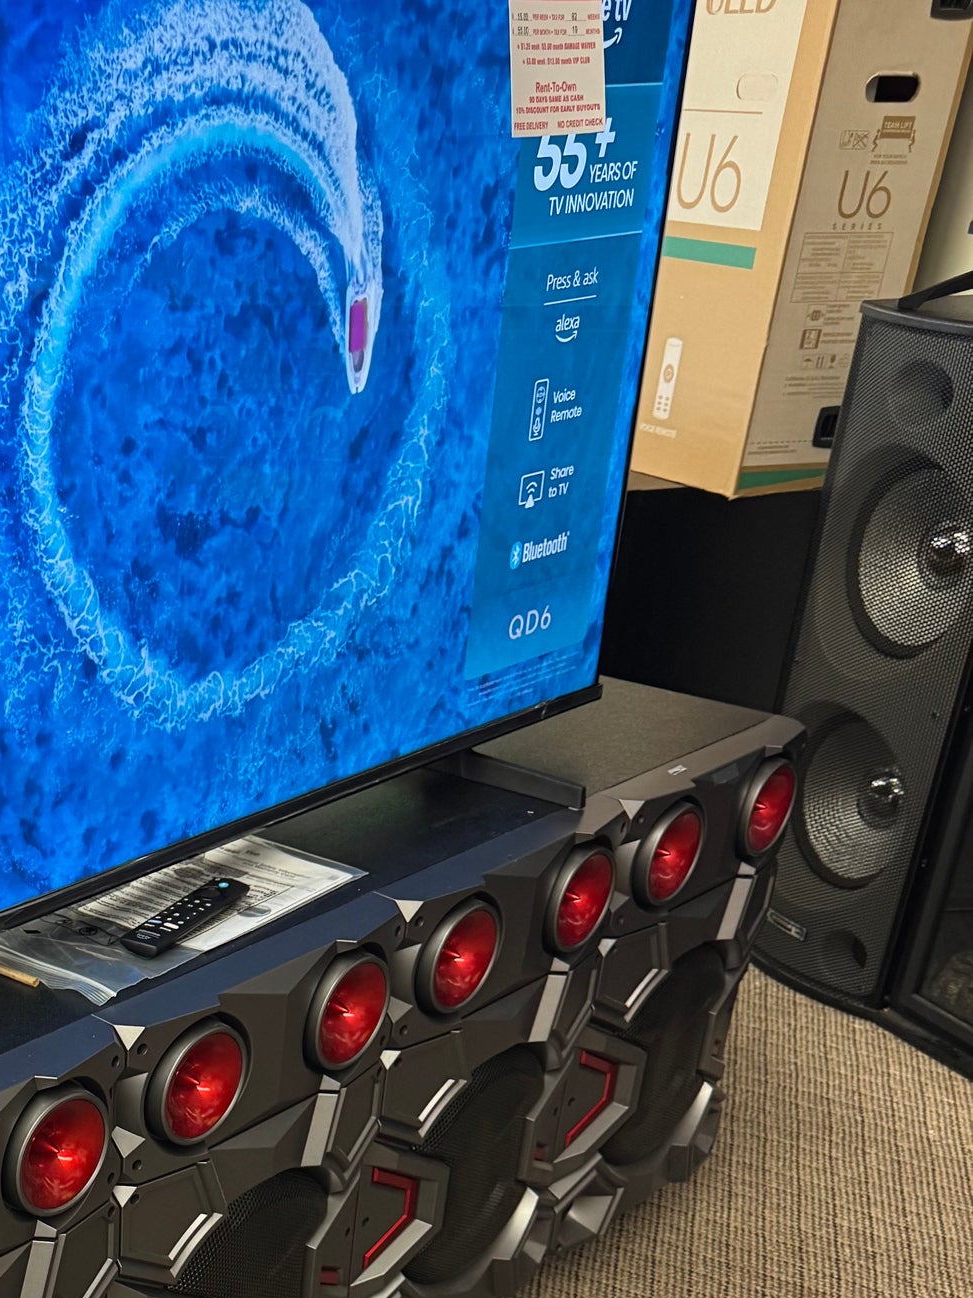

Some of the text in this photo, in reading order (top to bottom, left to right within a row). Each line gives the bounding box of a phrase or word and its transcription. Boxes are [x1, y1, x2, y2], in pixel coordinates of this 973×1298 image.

[535, 81, 577, 93] Rent-To-Own
[536, 95, 547, 103] DAYS
[576, 103, 600, 111] BUYOUTS
[514, 118, 603, 130] FREE DELIVERY NO CREDIT CHECK
[589, 160, 638, 183] YEARS OF
[677, 132, 742, 214] U6
[549, 189, 635, 216] TV INNOVATION
[838, 170, 892, 219] U6
[832, 222, 883, 231] SERIES
[546, 266, 599, 291] Press & ask
[555, 313, 580, 332] alexa
[553, 388, 576, 404] Voice
[550, 406, 583, 423] Remote
[550, 465, 575, 481] Share
[548, 482, 569, 498] to TV
[508, 605, 552, 640] QD6
